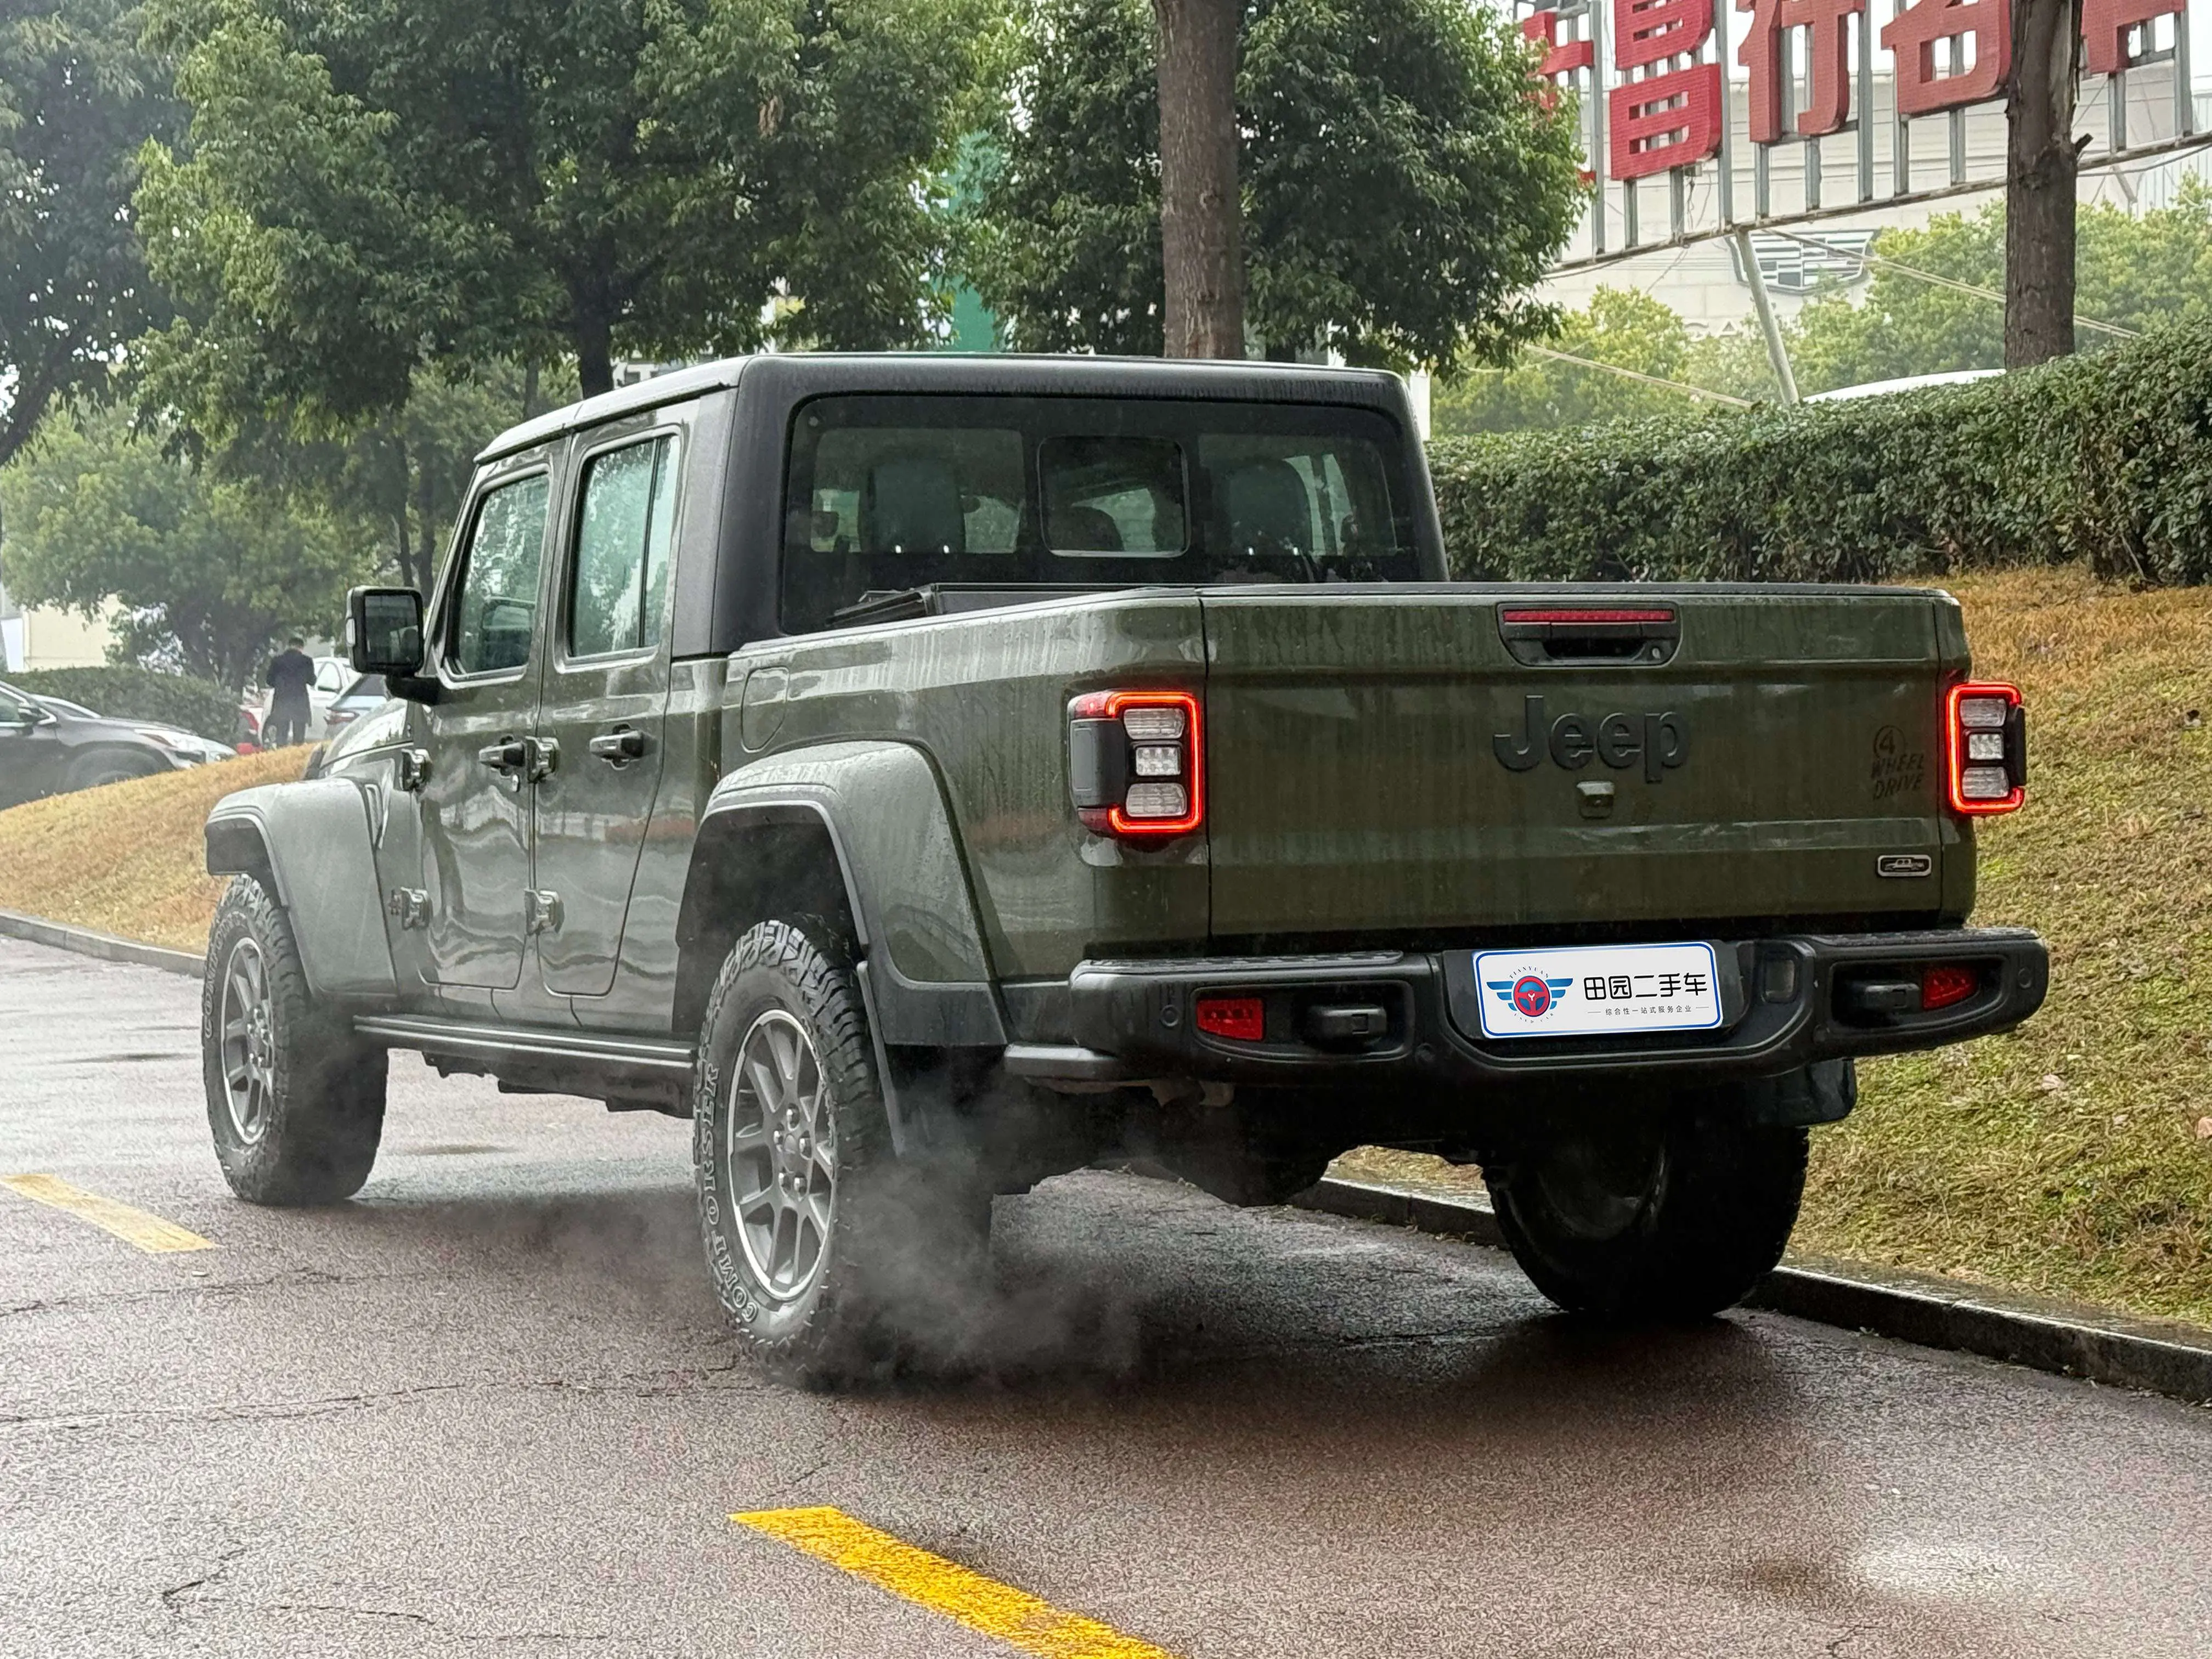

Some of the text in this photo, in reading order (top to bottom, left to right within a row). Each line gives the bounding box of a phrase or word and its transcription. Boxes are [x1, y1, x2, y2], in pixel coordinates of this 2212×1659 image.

[1493, 694, 1690, 784] Jeep
[1871, 752, 1925, 780] WHEEL
[1872, 772, 1925, 800] DRIVE
[1583, 973, 1708, 1000] 田园二手车
[1605, 1005, 1692, 1016] 综合性一站式服务企业
